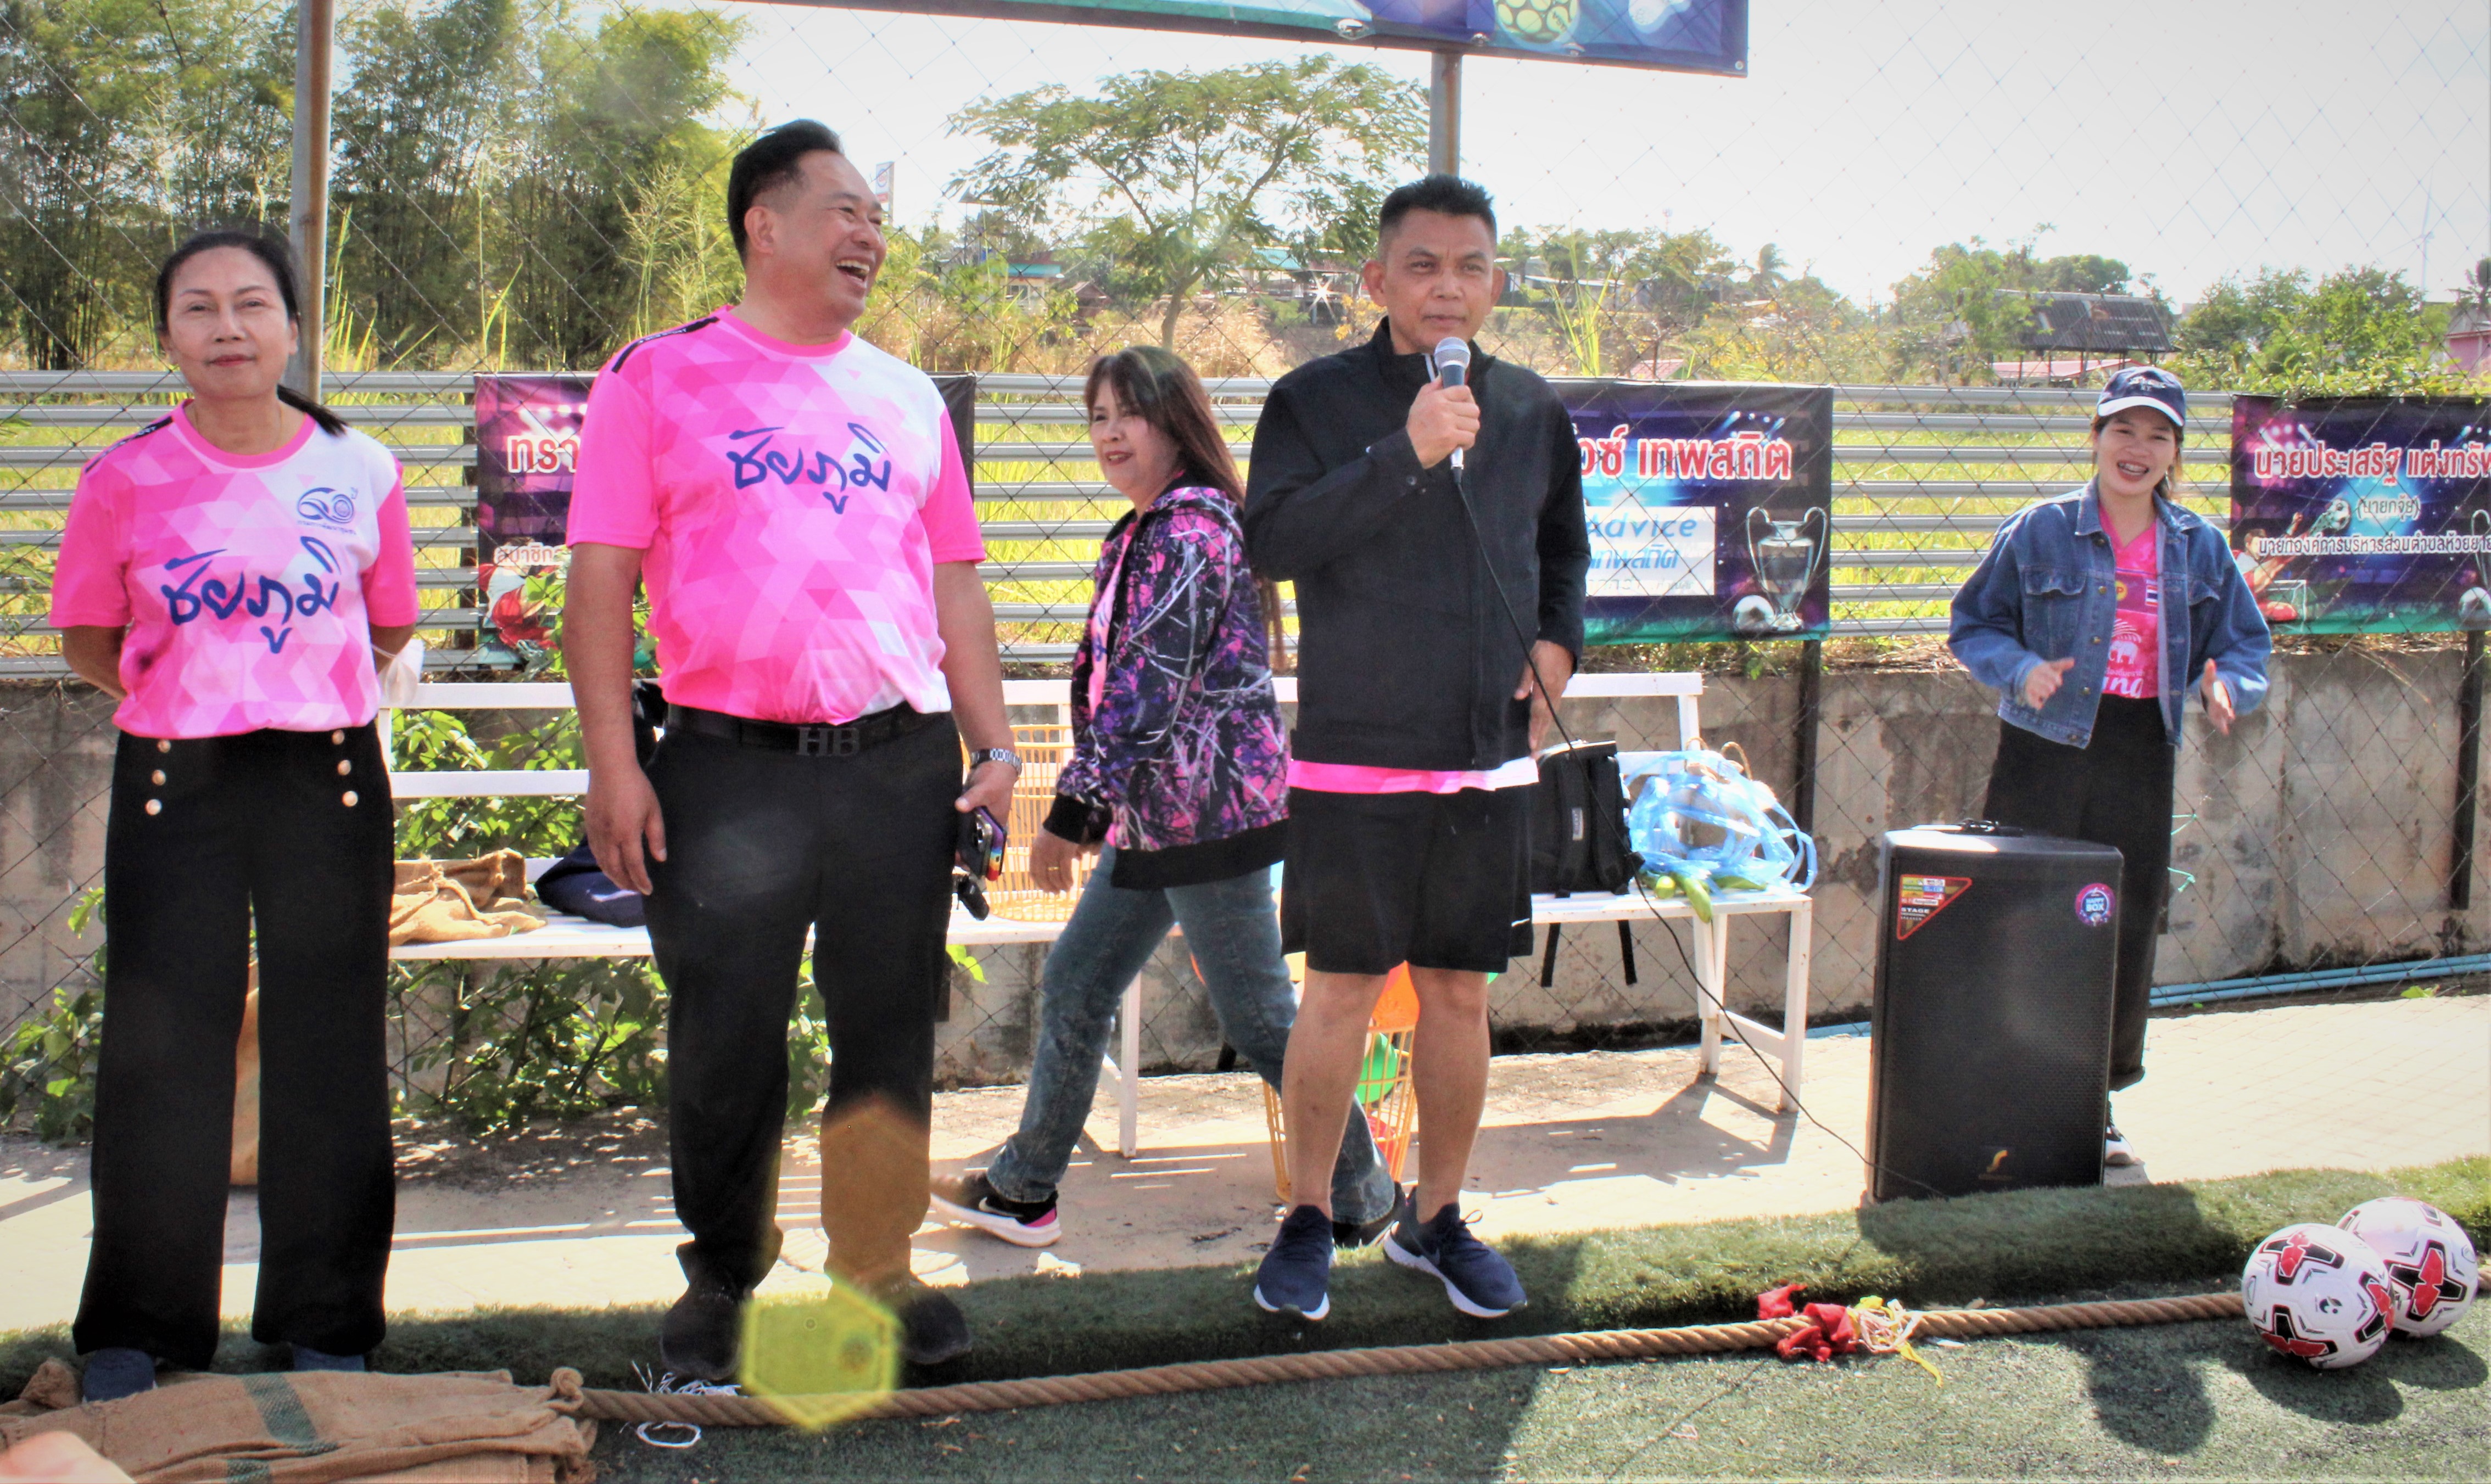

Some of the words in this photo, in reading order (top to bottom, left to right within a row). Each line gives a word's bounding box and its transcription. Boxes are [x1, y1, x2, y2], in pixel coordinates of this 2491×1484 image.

[725, 422, 892, 515] ชัยภูมิ
[1637, 430, 1792, 479] เทพสถิต
[2255, 440, 2401, 486] นายประเสริฐ
[1587, 513, 1697, 538] Advice
[160, 536, 341, 654] ชัยภูมิ
[797, 726, 861, 757] HB
